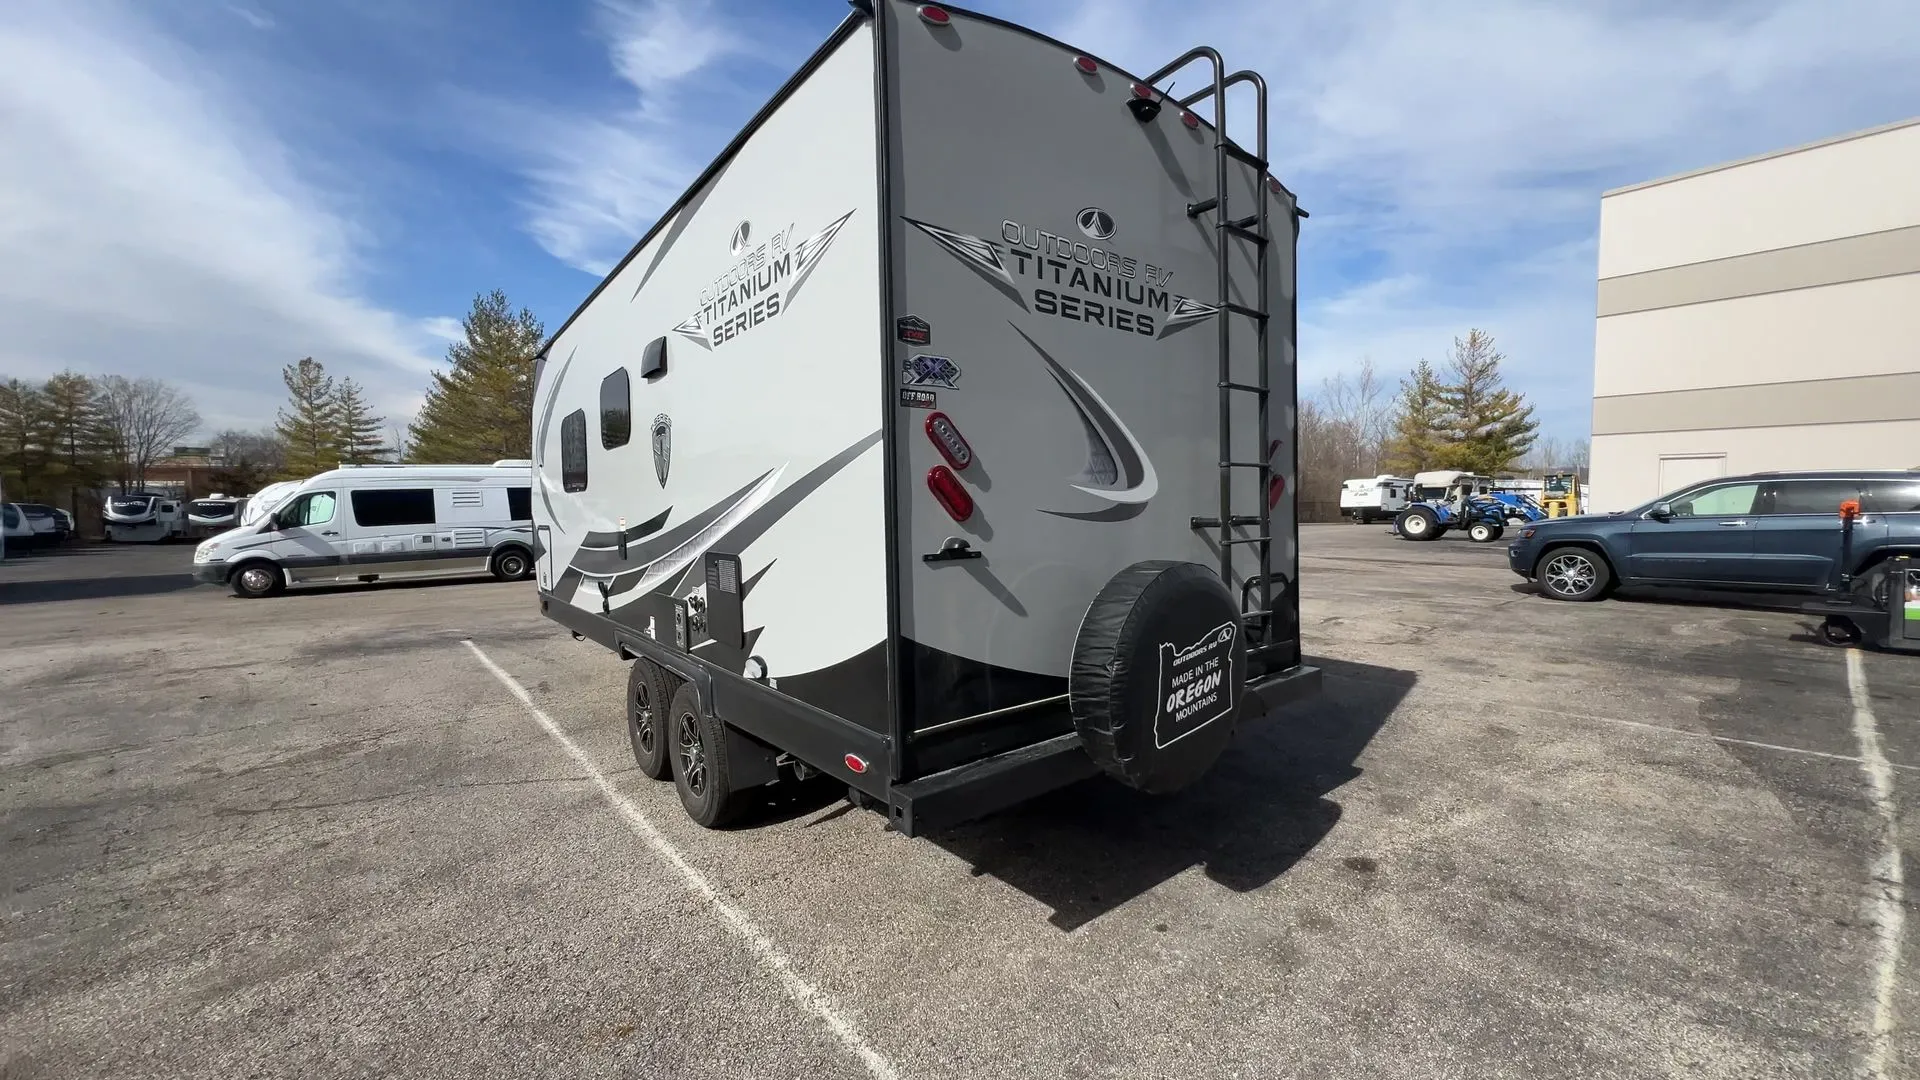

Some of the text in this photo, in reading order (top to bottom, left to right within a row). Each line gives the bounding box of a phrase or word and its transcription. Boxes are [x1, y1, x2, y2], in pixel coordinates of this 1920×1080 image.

[699, 222, 795, 306] OUTDOORS RV
[1001, 219, 1173, 288] OUTDOORS RV
[701, 252, 791, 325] TITANIUM
[1010, 248, 1169, 312] TITANIUM
[713, 292, 780, 347] SERIES
[1034, 288, 1155, 337] SERIES
[902, 391, 935, 402] OFF ROAD
[1171, 656, 1219, 688] MADE IN THE
[1173, 641, 1218, 667] OUTDOORS RV
[1166, 669, 1222, 713] OREGON
[1175, 692, 1218, 723] MOUNTAINS
